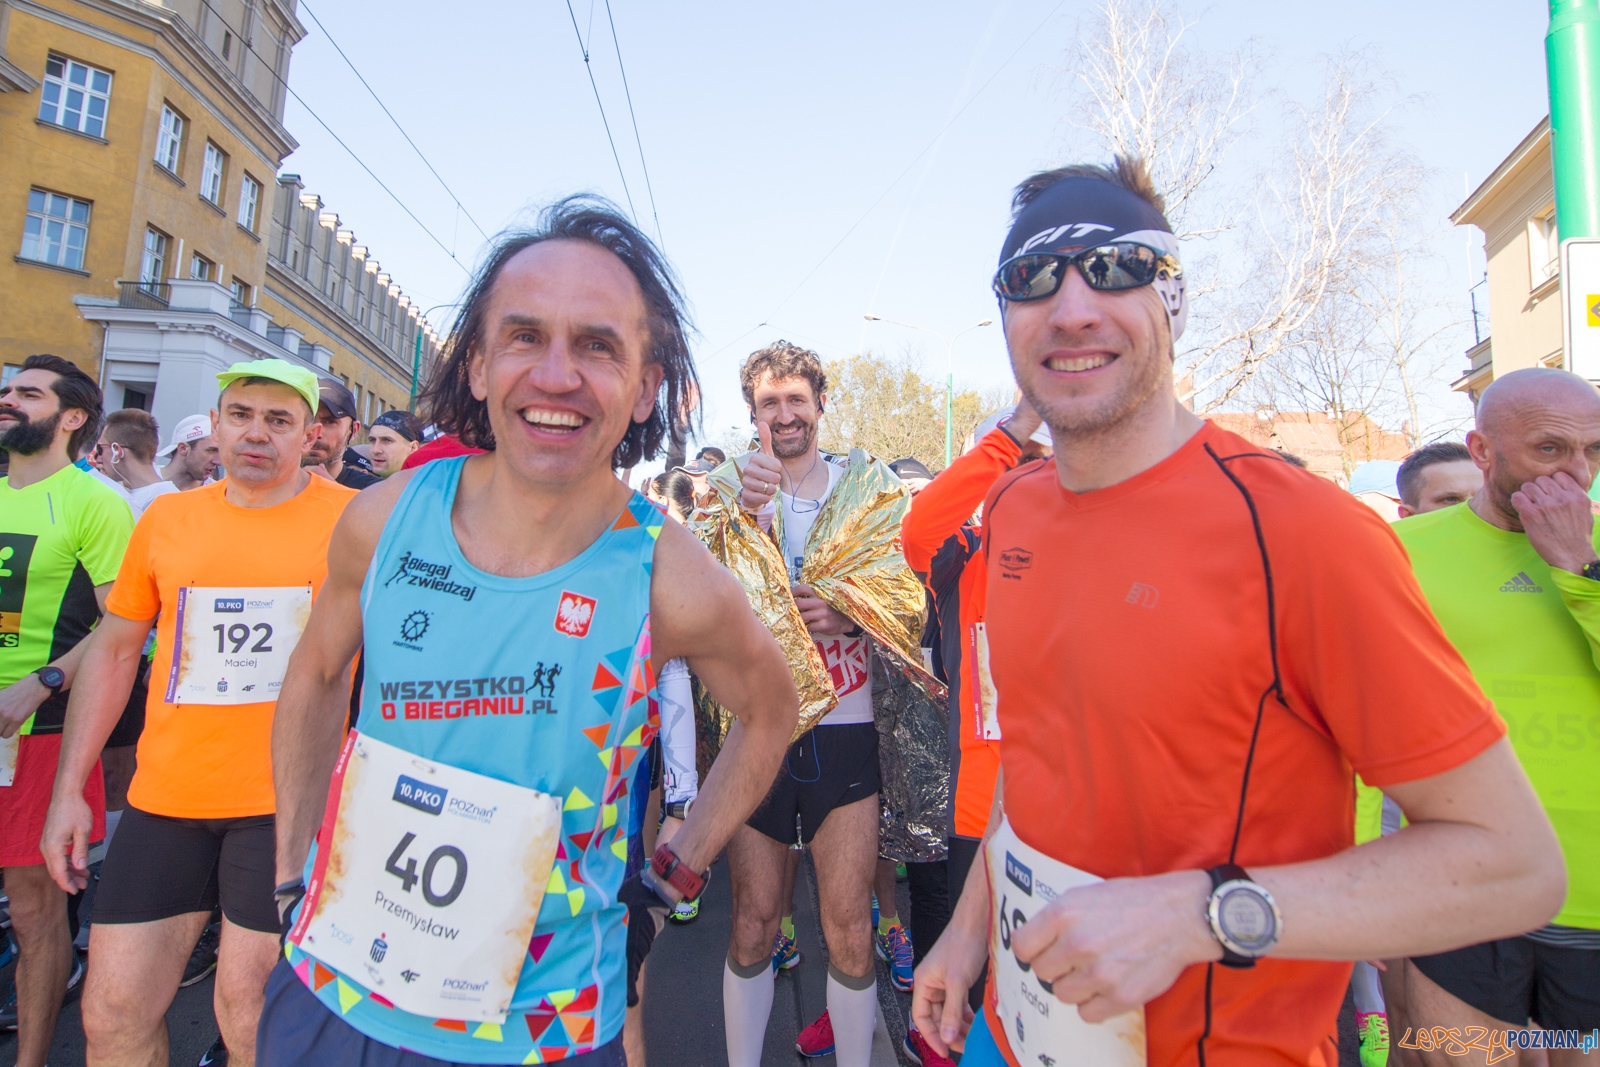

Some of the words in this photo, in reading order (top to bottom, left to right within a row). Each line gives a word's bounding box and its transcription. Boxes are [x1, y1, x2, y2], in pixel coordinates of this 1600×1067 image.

[1012, 222, 1115, 257] FIT
[408, 558, 452, 580] Biegaj
[408, 574, 477, 602] zwiedzaj
[1500, 582, 1544, 593] adidas
[212, 622, 273, 653] 192
[225, 659, 258, 668] Maciej
[380, 676, 524, 700] WSZYSTKO
[381, 701, 396, 720] O
[404, 697, 558, 720] BIEGANIU.PL
[384, 831, 468, 908] 40
[375, 890, 460, 941] Przemysław
[1021, 981, 1049, 1018] Rafał
